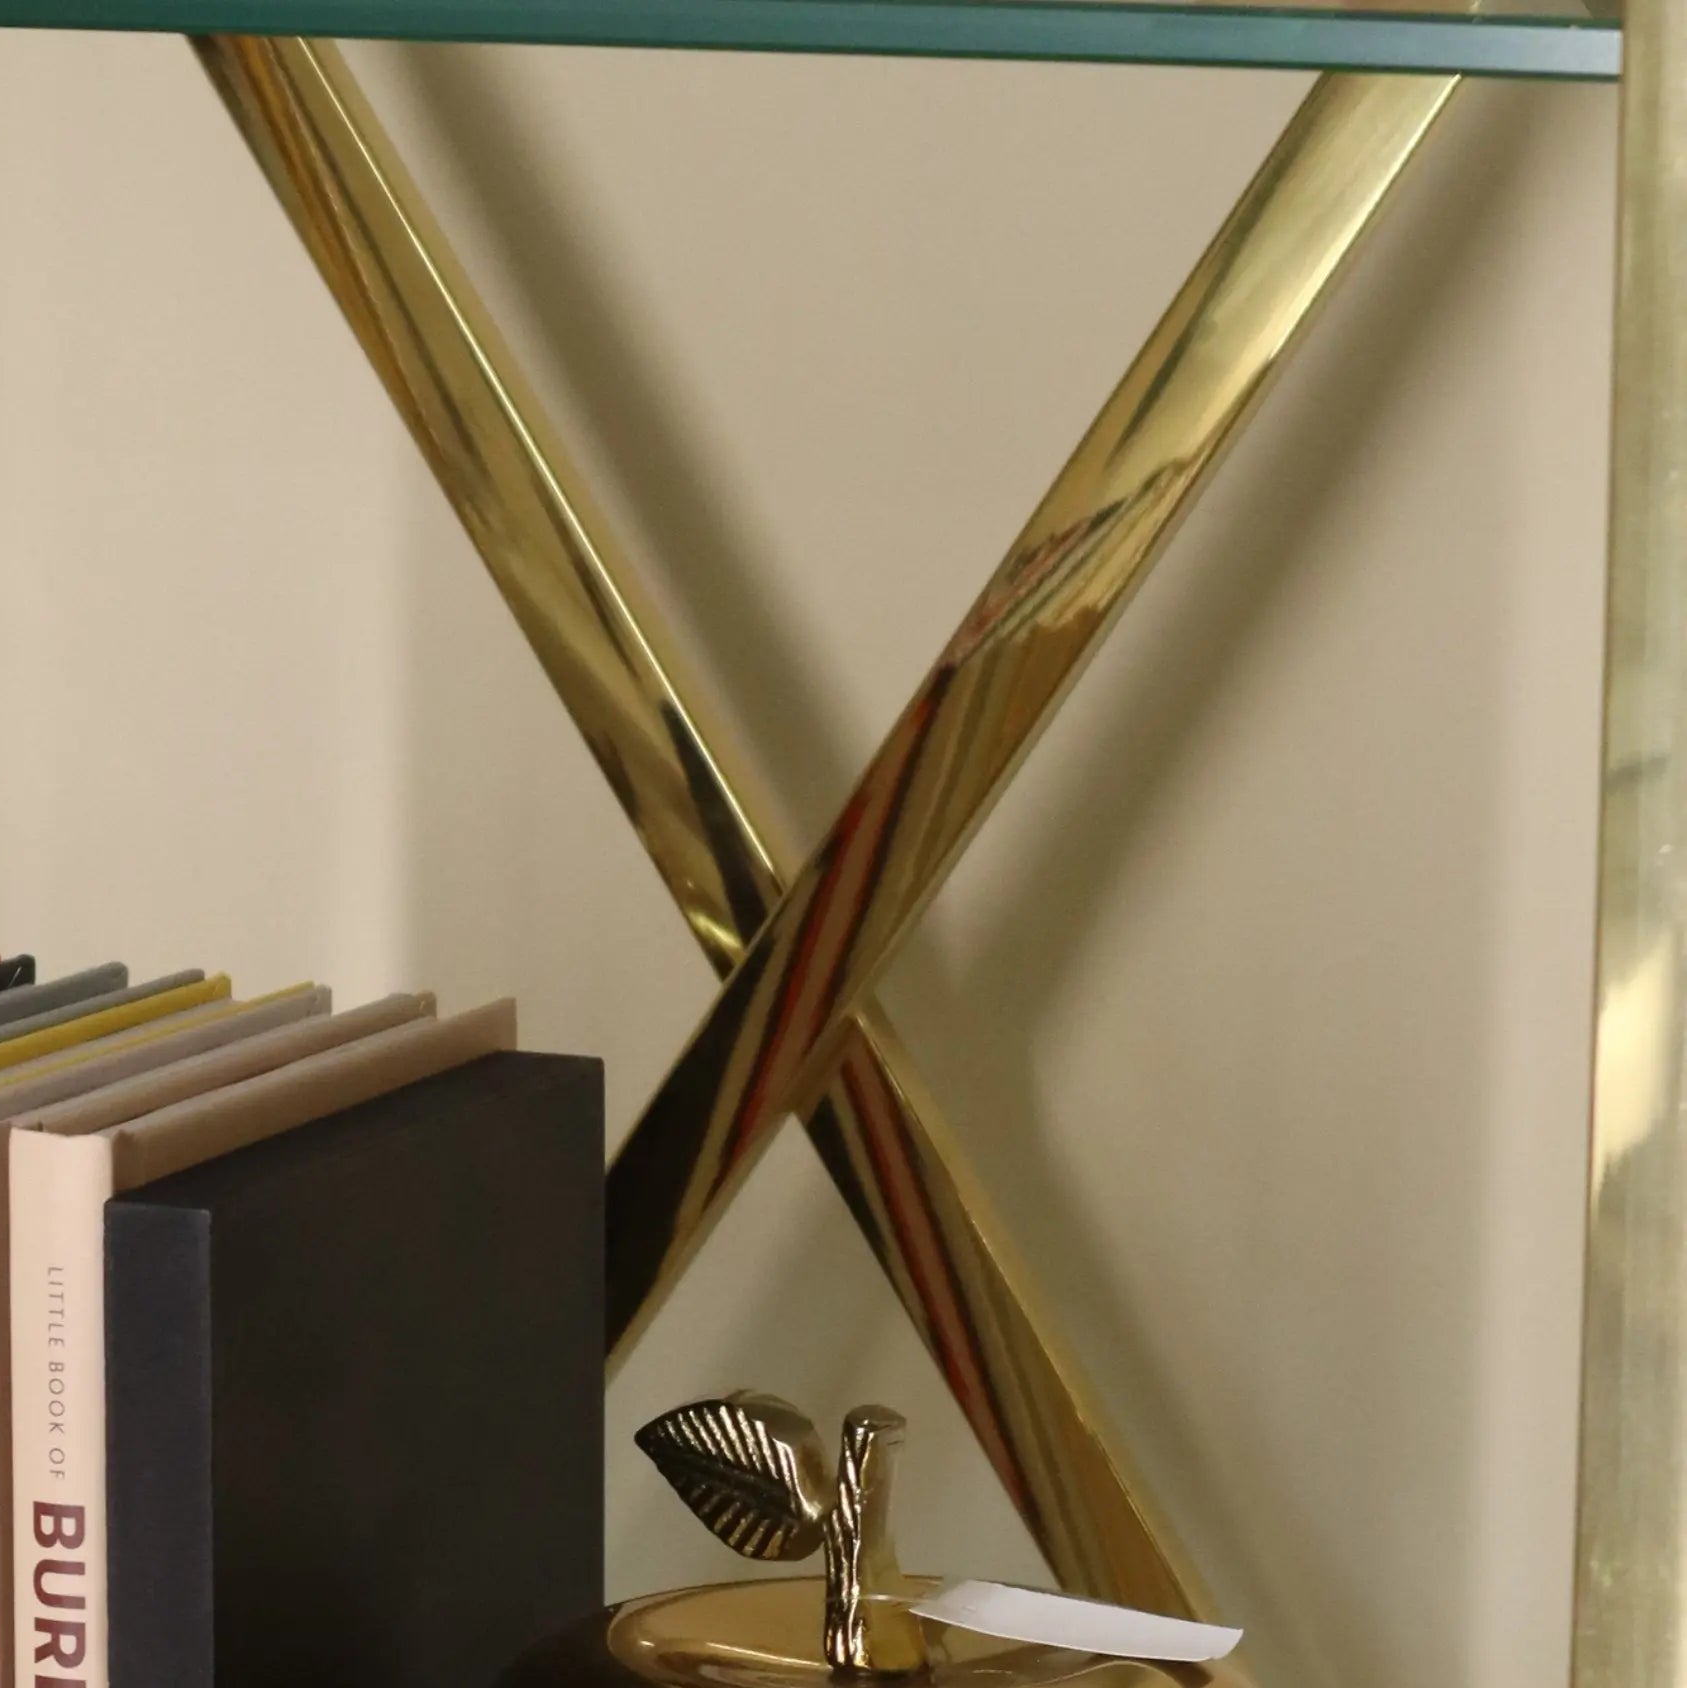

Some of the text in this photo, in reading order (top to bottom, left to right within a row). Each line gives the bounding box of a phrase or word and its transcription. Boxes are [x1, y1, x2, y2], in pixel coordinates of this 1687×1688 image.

[47, 1266, 64, 1347] LITTLE
[48, 1361, 65, 1434] BOOK
[49, 1448, 65, 1481] OF
